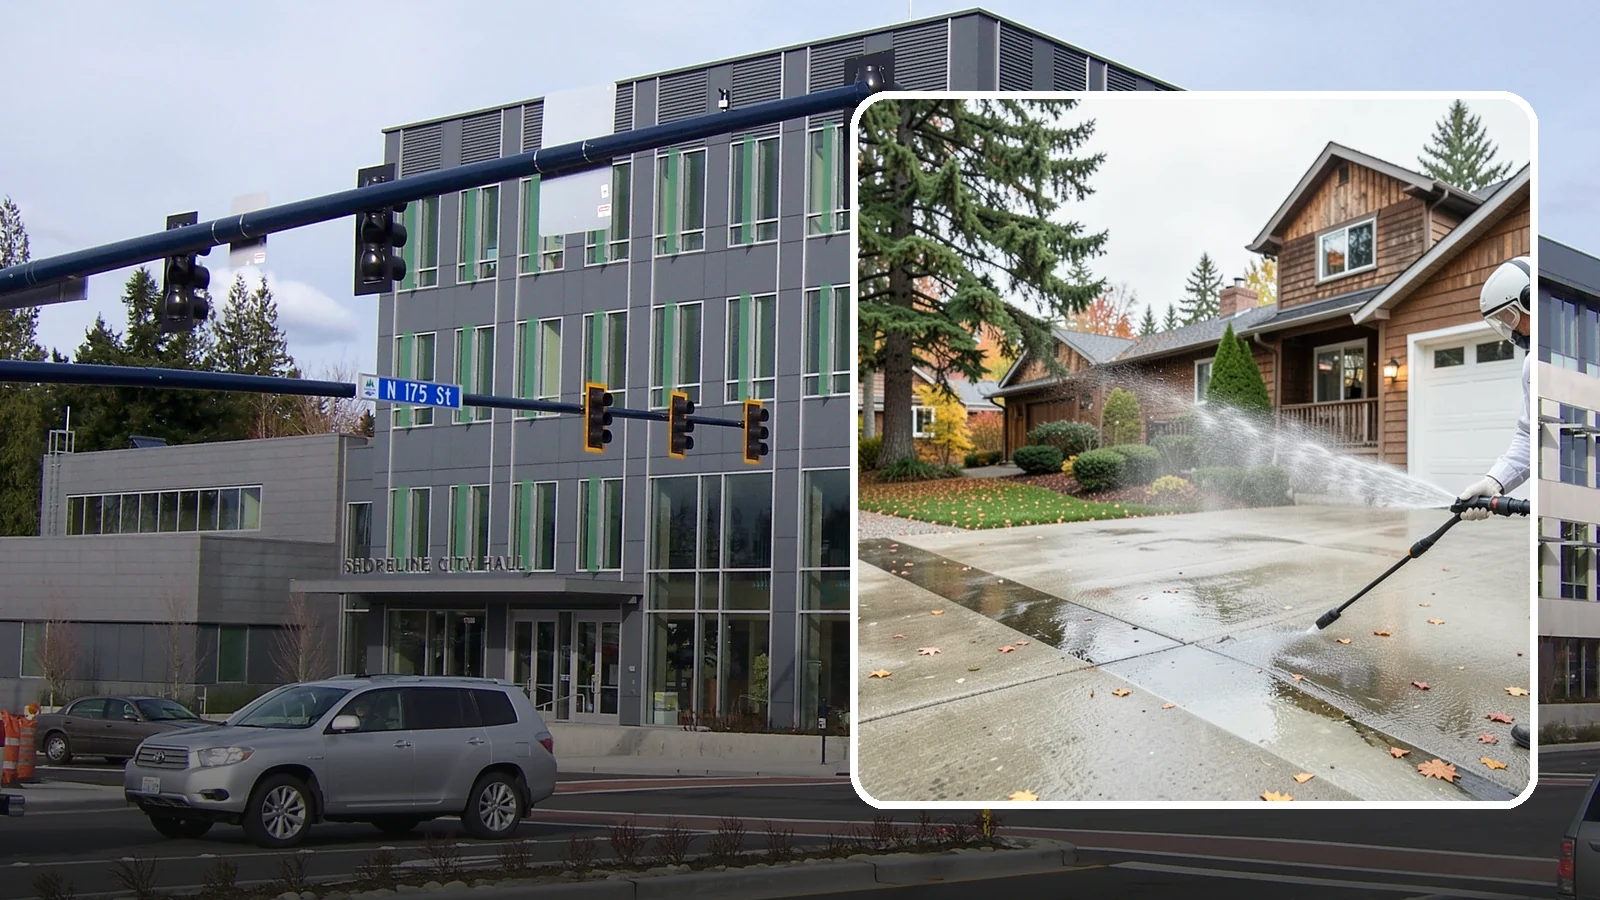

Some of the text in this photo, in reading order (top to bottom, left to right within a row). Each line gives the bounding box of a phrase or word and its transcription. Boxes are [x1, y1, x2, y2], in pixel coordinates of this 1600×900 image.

[387, 380, 451, 406] N 175 St
[344, 555, 525, 574] SHORELINE CITY HALL
